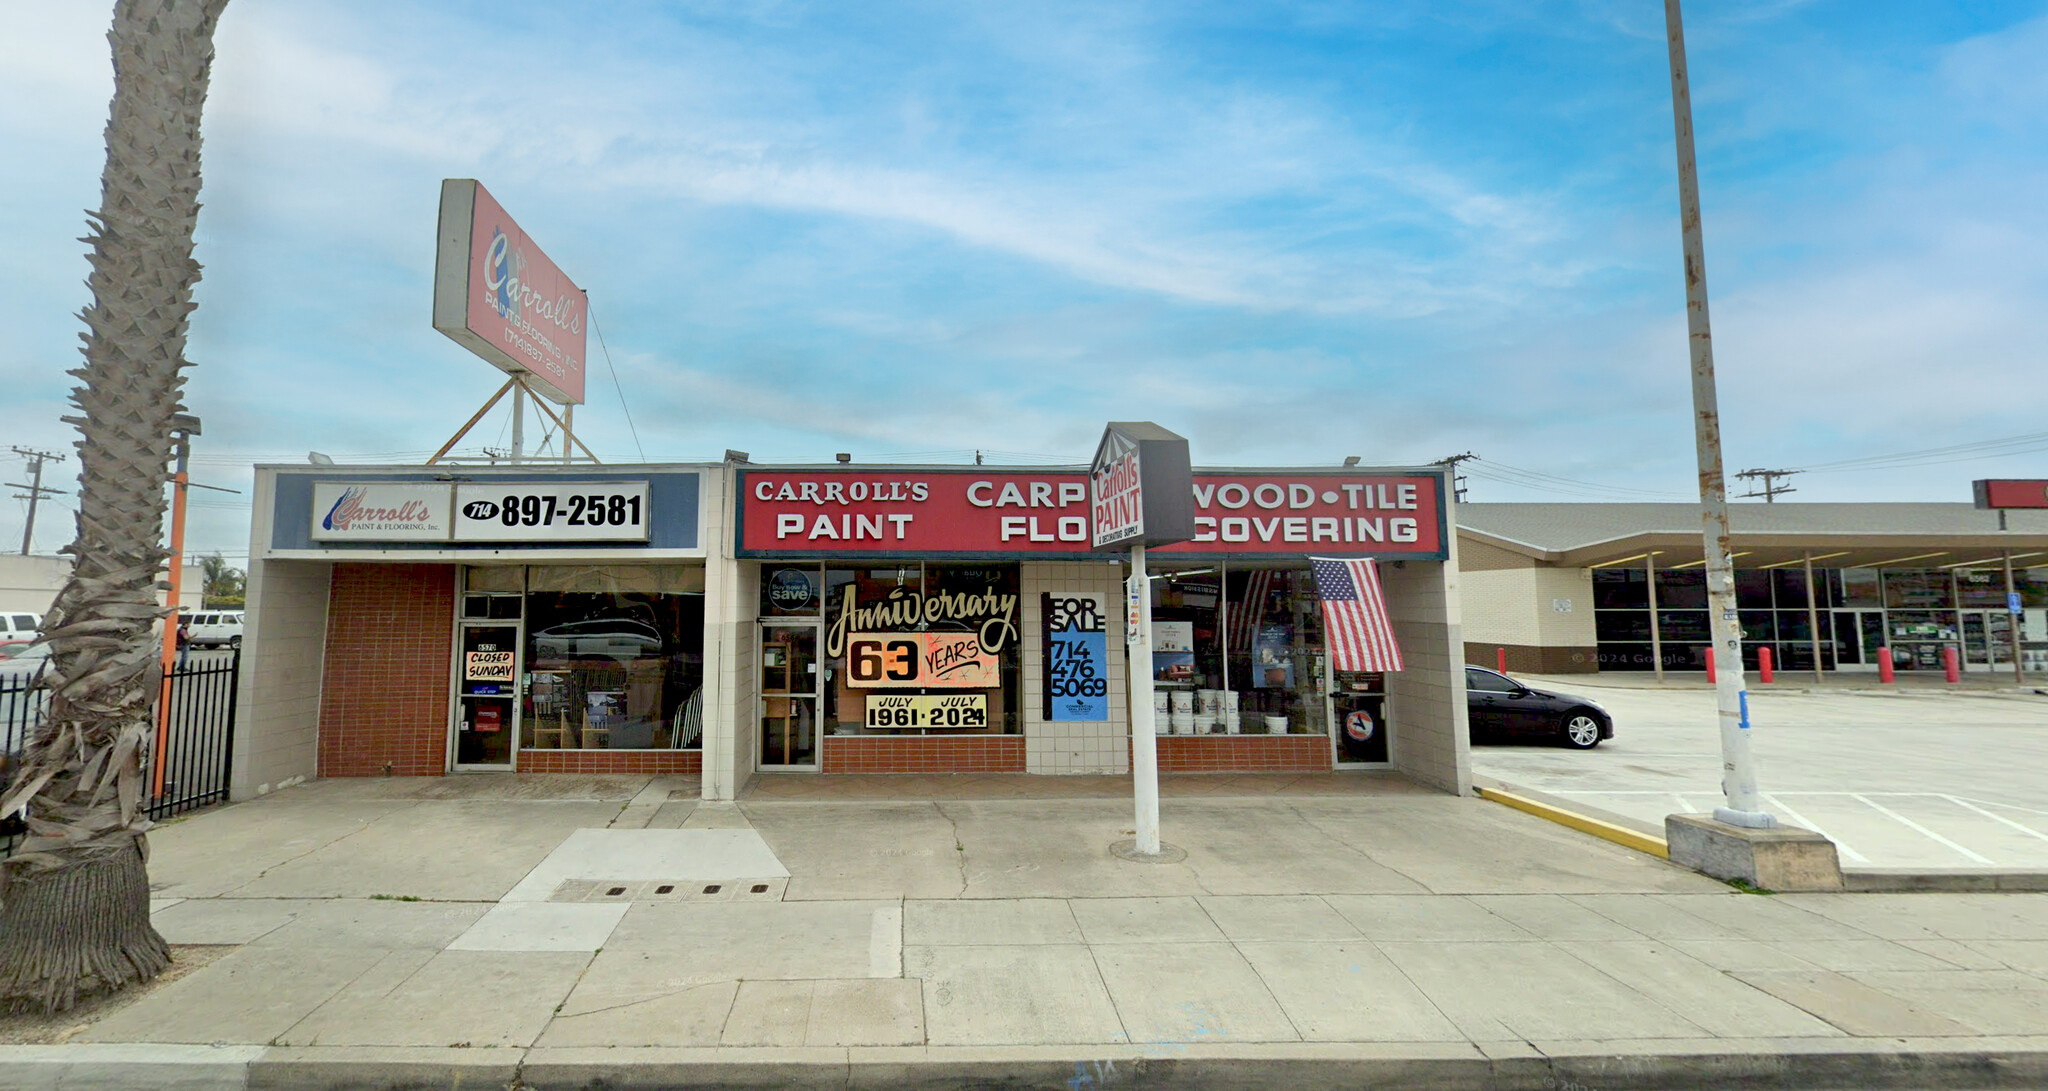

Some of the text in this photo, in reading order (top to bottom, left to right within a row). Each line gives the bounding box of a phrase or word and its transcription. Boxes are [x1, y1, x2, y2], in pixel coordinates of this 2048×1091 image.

[484, 232, 581, 335] Carroll's
[485, 291, 514, 323] PAINT
[1096, 454, 1138, 503] Carroll's
[755, 481, 929, 505] CARROLL'S
[966, 480, 1086, 507] CARP
[1341, 483, 1418, 510] TILE
[332, 498, 430, 524] Carroll's
[470, 494, 641, 527] 714 897-2581
[1095, 487, 1140, 535] PAINT
[351, 523, 375, 531] PAINT
[384, 523, 426, 532] FLOORING,
[428, 523, 440, 531] Inc.
[777, 513, 1418, 543] PAINT FLO COVERING
[1123, 525, 1138, 538] SUPPLY
[772, 583, 785, 591] Buy
[772, 589, 808, 600] save
[1050, 598, 1097, 616] FOR
[827, 584, 1018, 658] Anniversary
[1050, 615, 1106, 633] SALE
[471, 653, 510, 663] CLOSED
[925, 640, 979, 674] YEARS
[1050, 640, 1091, 660] 714
[850, 640, 919, 681] 63
[1050, 659, 1095, 678] 476
[469, 665, 513, 677] SUNDAY
[1051, 678, 1108, 698] 5069
[878, 697, 977, 708] JULY JULY
[869, 708, 985, 726] 1961 2024
